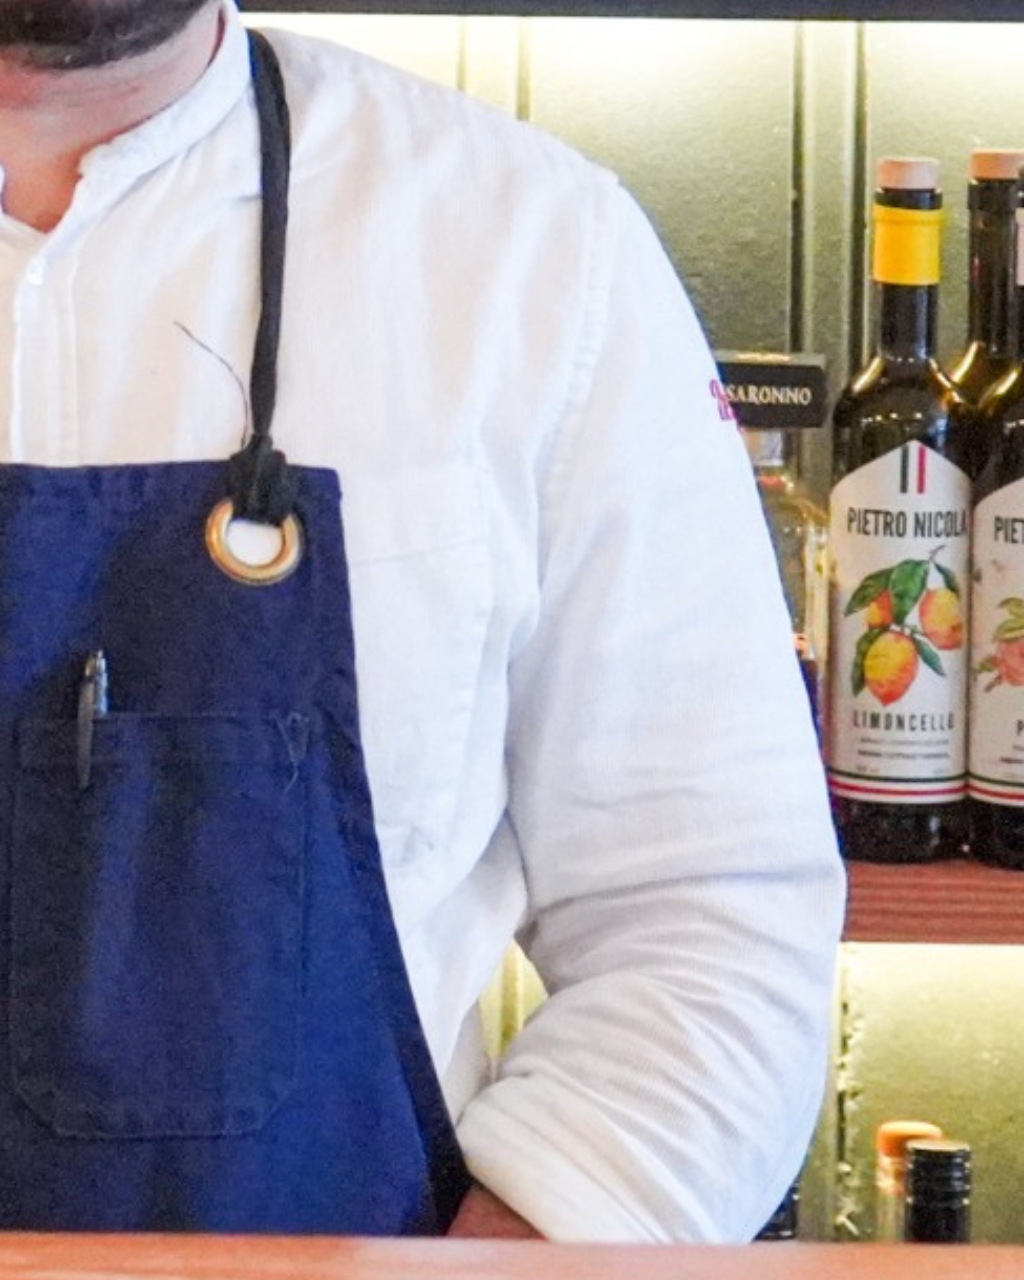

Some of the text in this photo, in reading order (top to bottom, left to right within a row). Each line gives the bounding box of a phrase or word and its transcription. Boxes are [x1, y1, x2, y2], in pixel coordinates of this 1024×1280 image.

[847, 506, 967, 538] PIETRO NICOLA
[853, 708, 955, 731] LIMONCELLO
